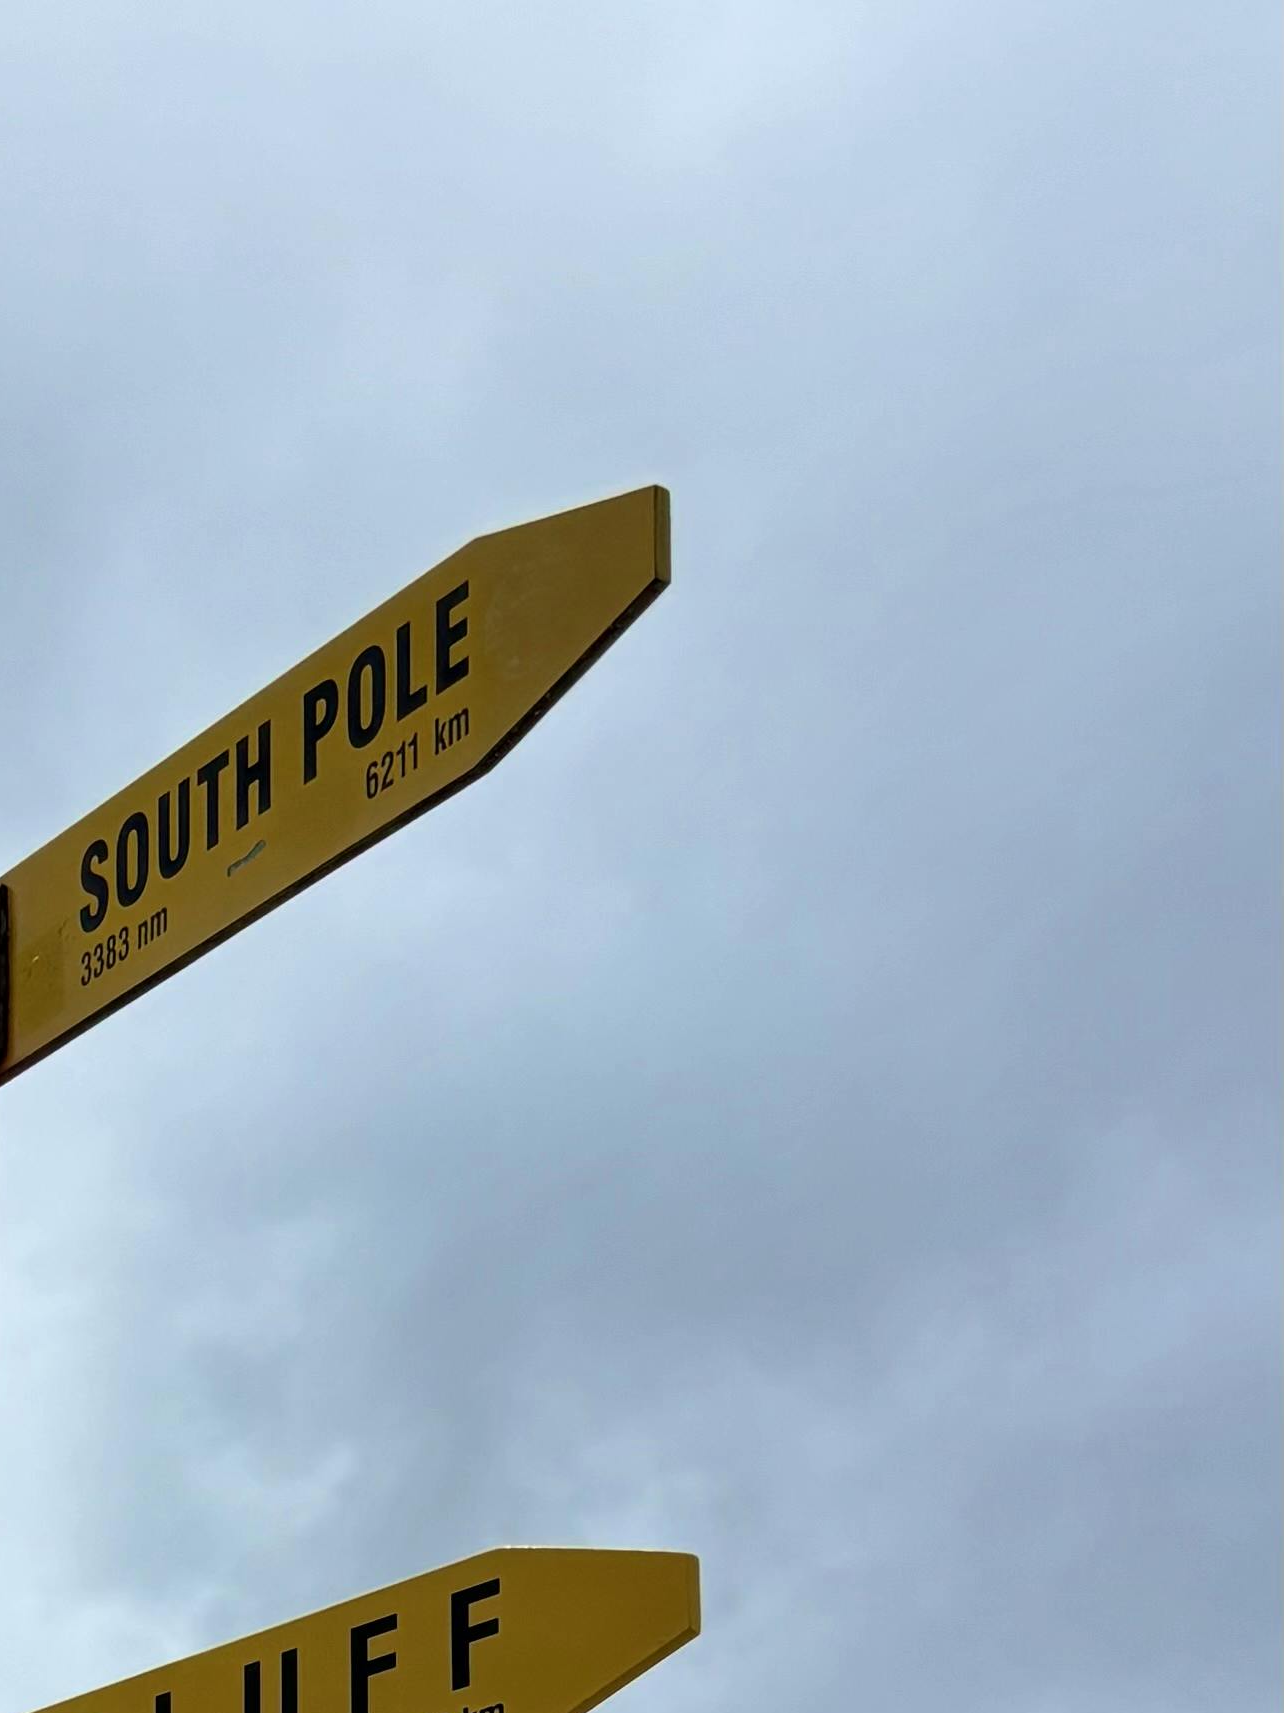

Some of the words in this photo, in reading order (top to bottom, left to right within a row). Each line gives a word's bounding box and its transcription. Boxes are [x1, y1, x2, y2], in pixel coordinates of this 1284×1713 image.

[78, 717, 273, 936] SOUTH
[303, 579, 471, 787] POLE
[365, 730, 420, 800] 6211
[434, 707, 471, 757] km
[80, 924, 131, 988] 3383
[137, 906, 168, 951] nm
